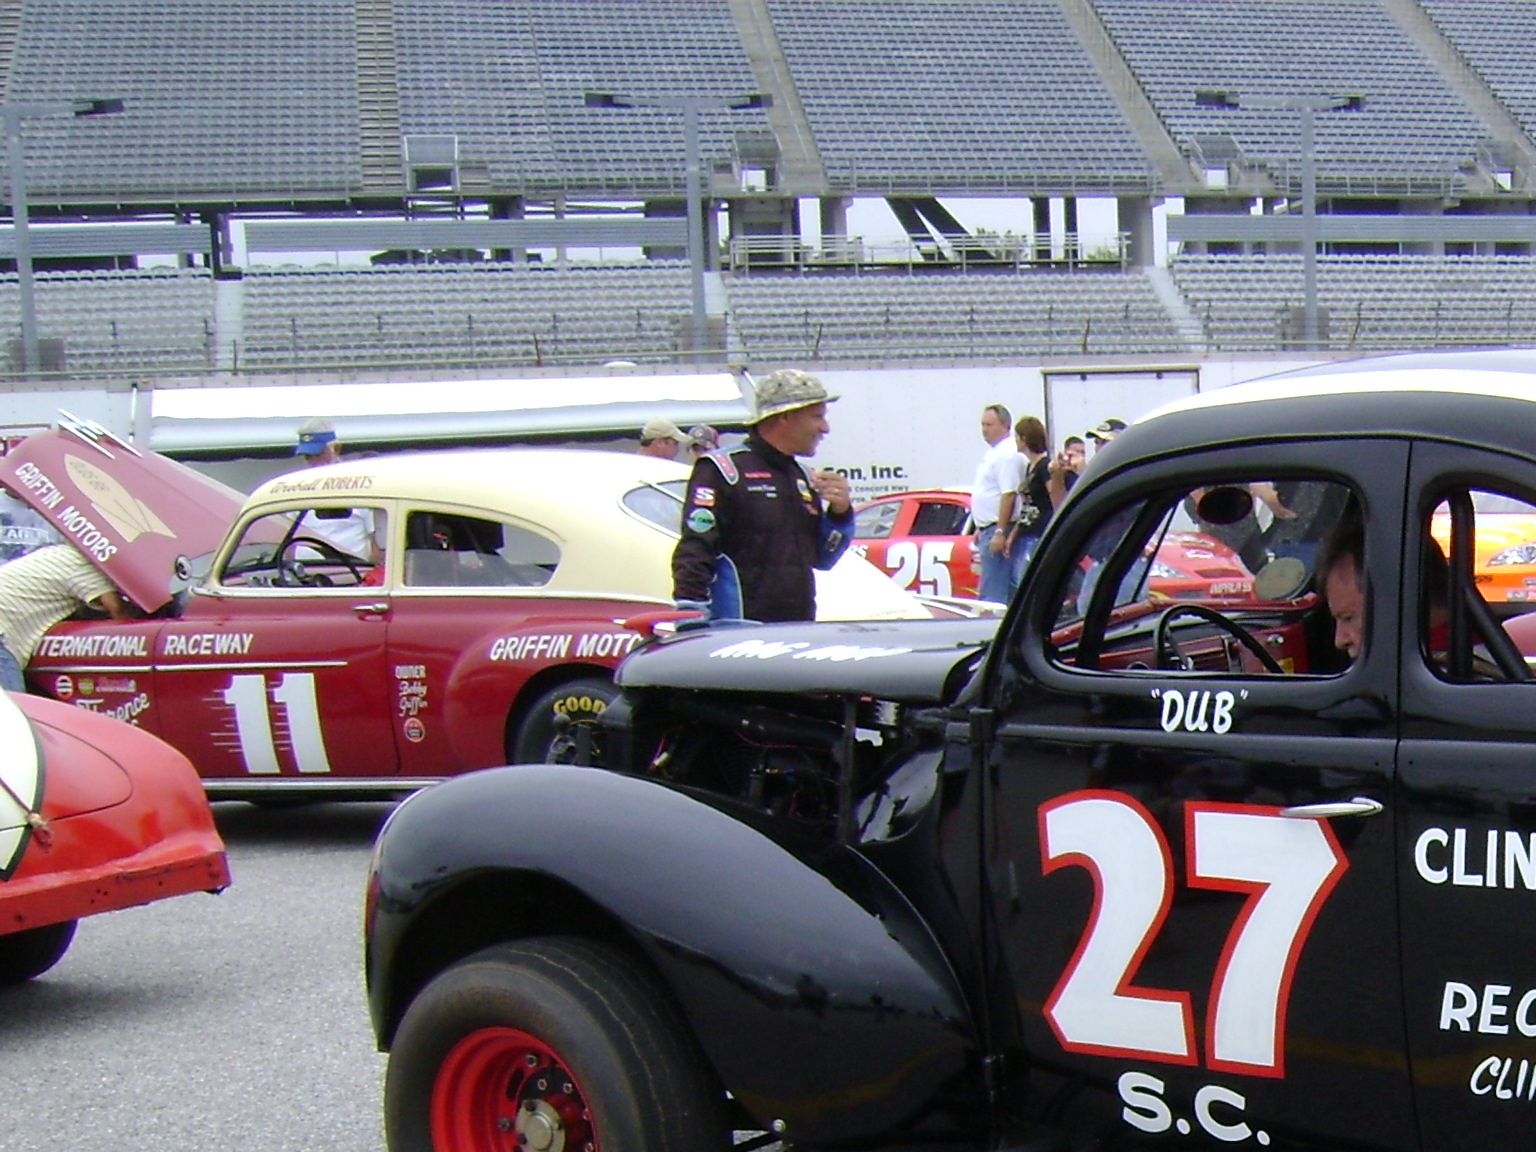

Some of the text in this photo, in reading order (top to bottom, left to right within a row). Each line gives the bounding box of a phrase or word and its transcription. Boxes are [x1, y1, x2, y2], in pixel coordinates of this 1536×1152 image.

[321, 475, 376, 491] ROBERTS
[870, 464, 908, 480] Inc.
[15, 462, 64, 510] GRIFFIN
[57, 505, 118, 562] MOTORS
[886, 541, 955, 598] 25
[34, 633, 254, 657] TERNATIONAL RACEWAY
[489, 634, 572, 661] GRIFFIN
[224, 672, 331, 774] 11
[1151, 688, 1249, 735] "DUB"
[1037, 788, 1350, 1079] 27
[1118, 1071, 1270, 1146] S.C.
